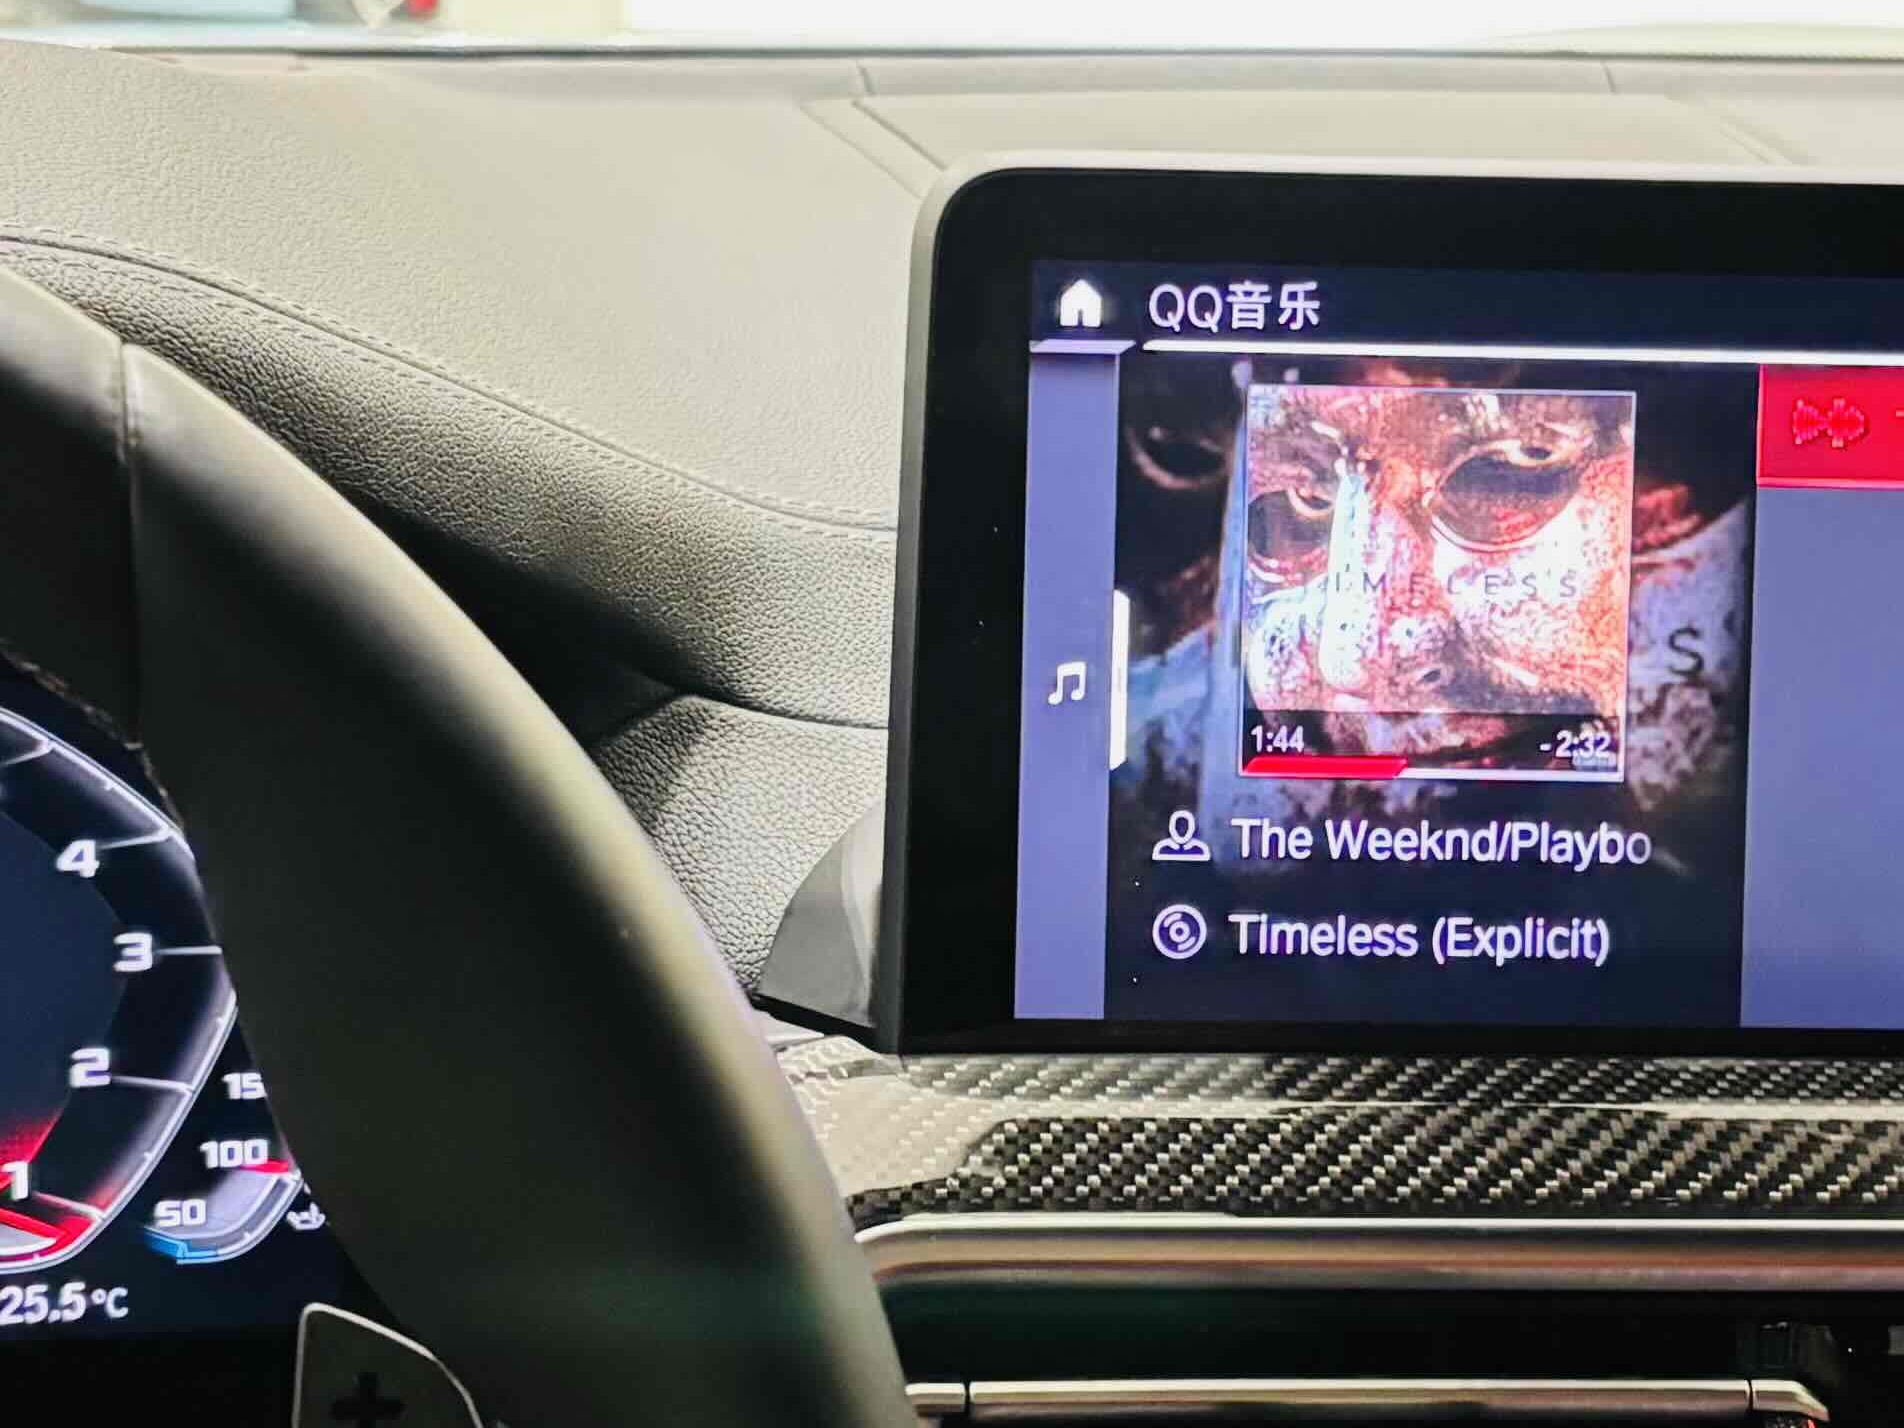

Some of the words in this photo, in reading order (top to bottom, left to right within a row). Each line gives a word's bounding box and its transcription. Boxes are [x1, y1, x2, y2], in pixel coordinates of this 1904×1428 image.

[1148, 280, 1322, 332] QQ音乐
[1250, 725, 1305, 754] 1:44
[57, 839, 100, 876] 4
[1229, 817, 1312, 862] The
[1323, 818, 1653, 872] Weeknd/Playbo
[112, 933, 154, 972] 3
[1229, 914, 1419, 958] Timeless
[1431, 917, 1610, 966] (Explicit)
[69, 1047, 112, 1087] 2
[223, 1072, 267, 1100] 15
[199, 1138, 269, 1170] 100
[1, 1160, 31, 1199] 1
[153, 1198, 208, 1228] 50
